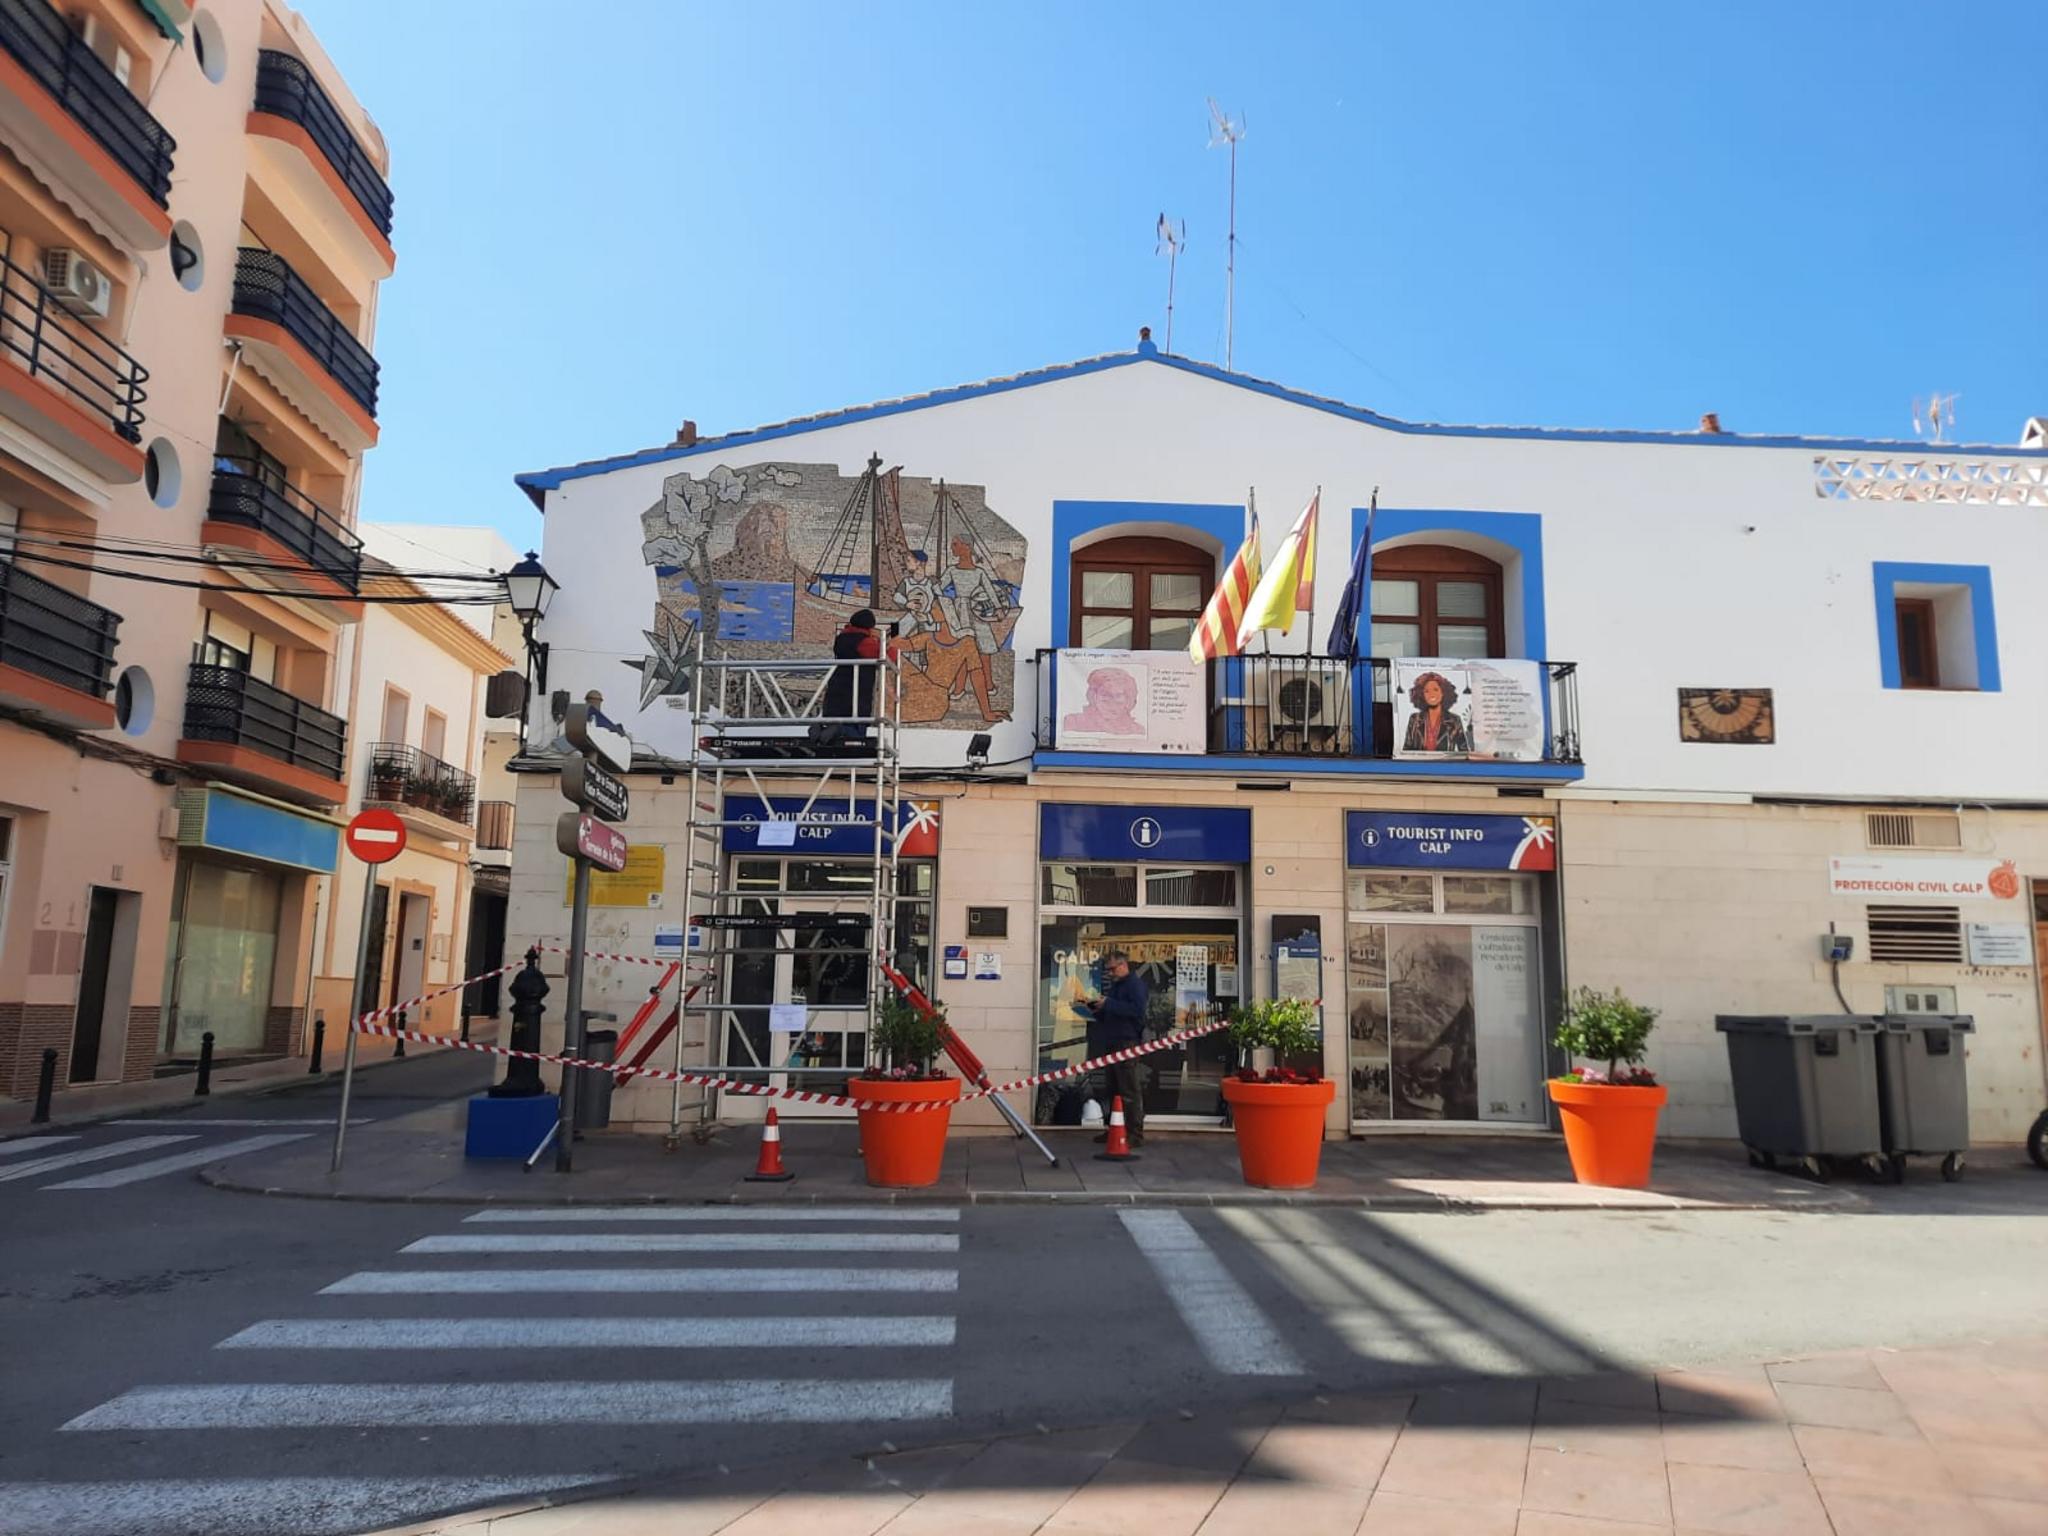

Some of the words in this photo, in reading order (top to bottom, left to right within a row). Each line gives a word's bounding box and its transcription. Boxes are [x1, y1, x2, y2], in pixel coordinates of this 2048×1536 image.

[799, 827, 832, 839] CALP
[1387, 827, 1447, 841] TOURIST
[1450, 828, 1484, 841] INFO
[1420, 842, 1452, 854] CALP
[1918, 881, 1949, 893] CIVIL
[1952, 882, 1984, 894] CALP
[1053, 950, 1101, 965] CALP
